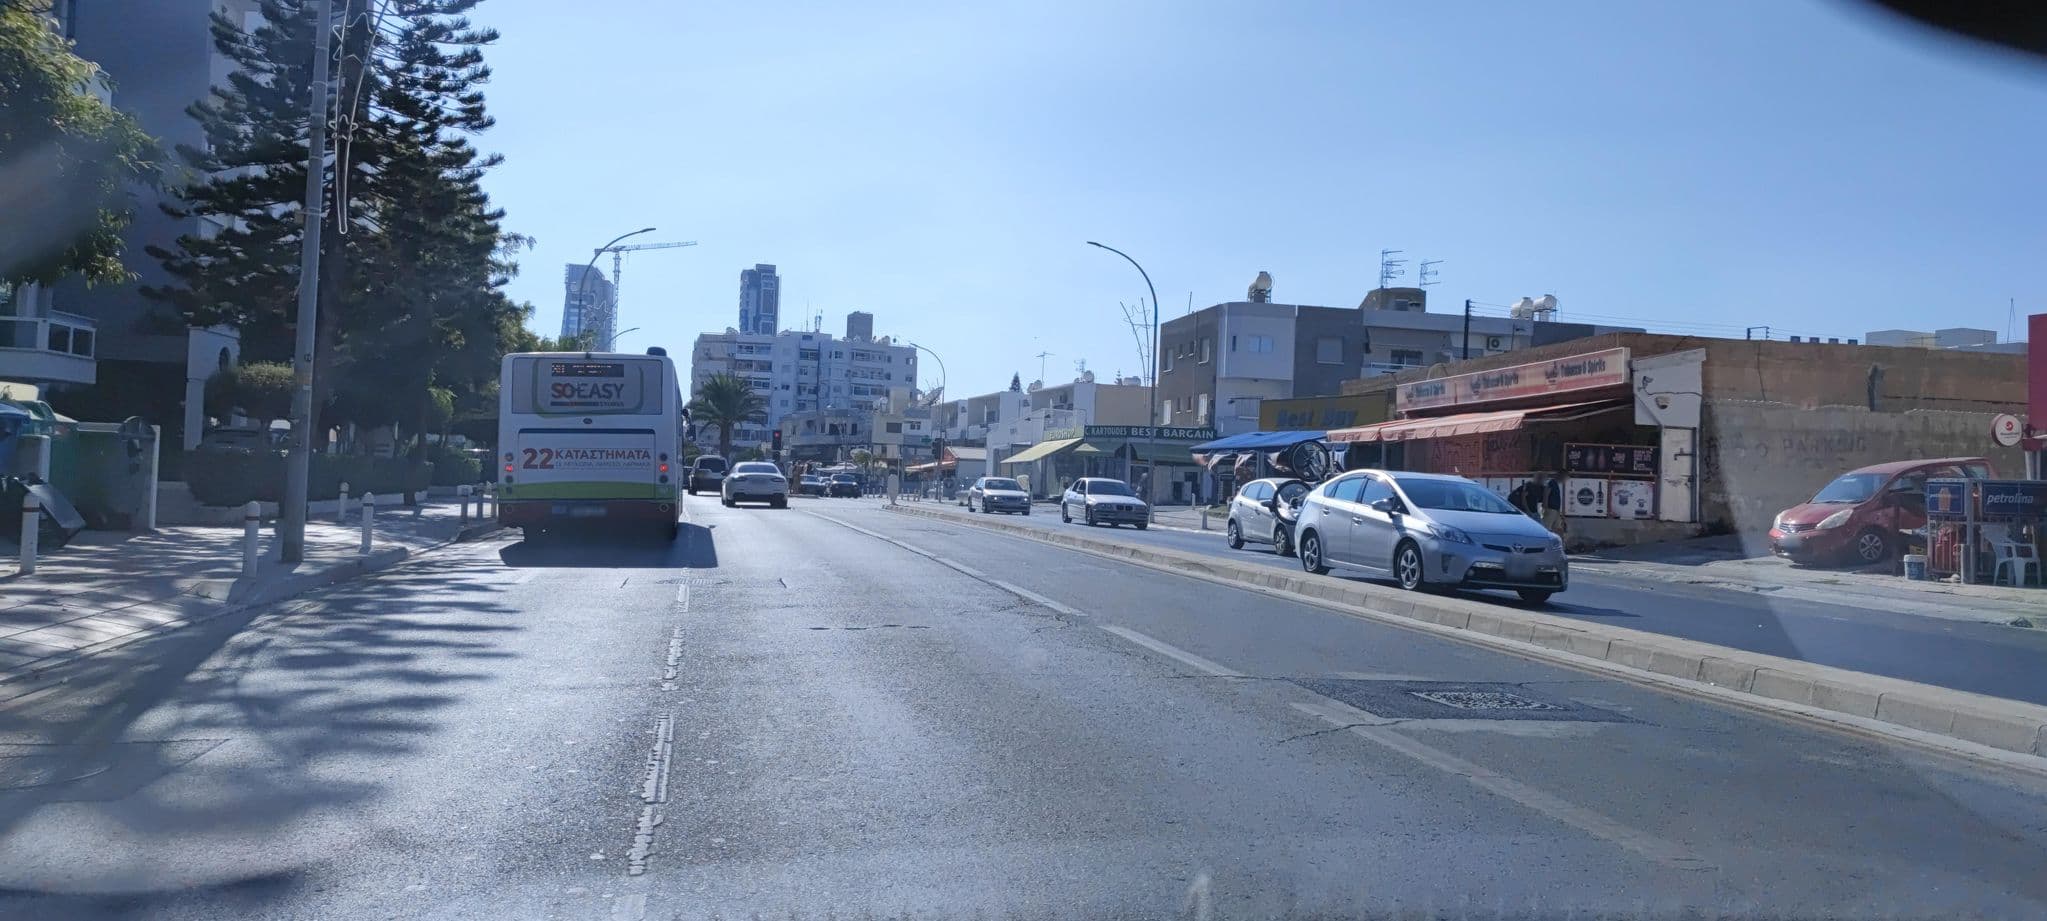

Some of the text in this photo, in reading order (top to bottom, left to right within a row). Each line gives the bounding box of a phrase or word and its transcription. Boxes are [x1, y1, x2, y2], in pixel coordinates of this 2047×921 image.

[1588, 358, 1606, 375] Spirits
[1131, 427, 1158, 436] BEST
[1163, 429, 1214, 440] BARGAIN
[522, 448, 554, 470] 22
[555, 449, 651, 460] ΚΑΤΑΣΤΗΜΑΤΑ
[1986, 492, 2034, 505] petrolina
